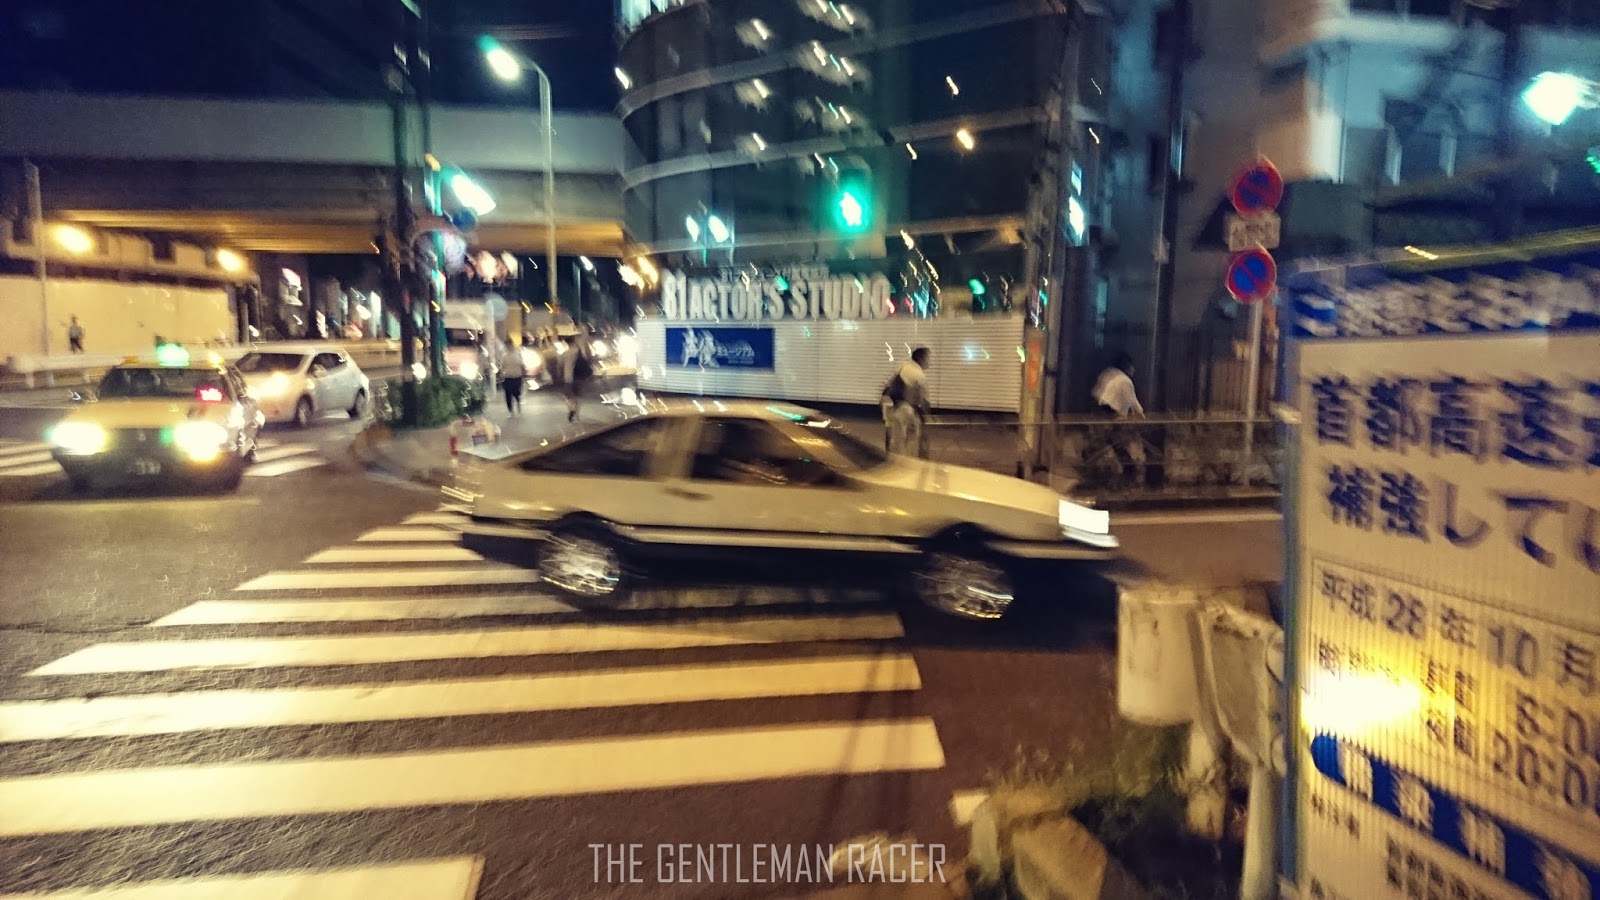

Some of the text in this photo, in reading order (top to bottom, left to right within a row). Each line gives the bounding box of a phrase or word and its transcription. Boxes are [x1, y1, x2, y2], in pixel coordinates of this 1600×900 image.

[789, 274, 891, 321] STUDIO
[1311, 376, 1600, 467] 首都高速
